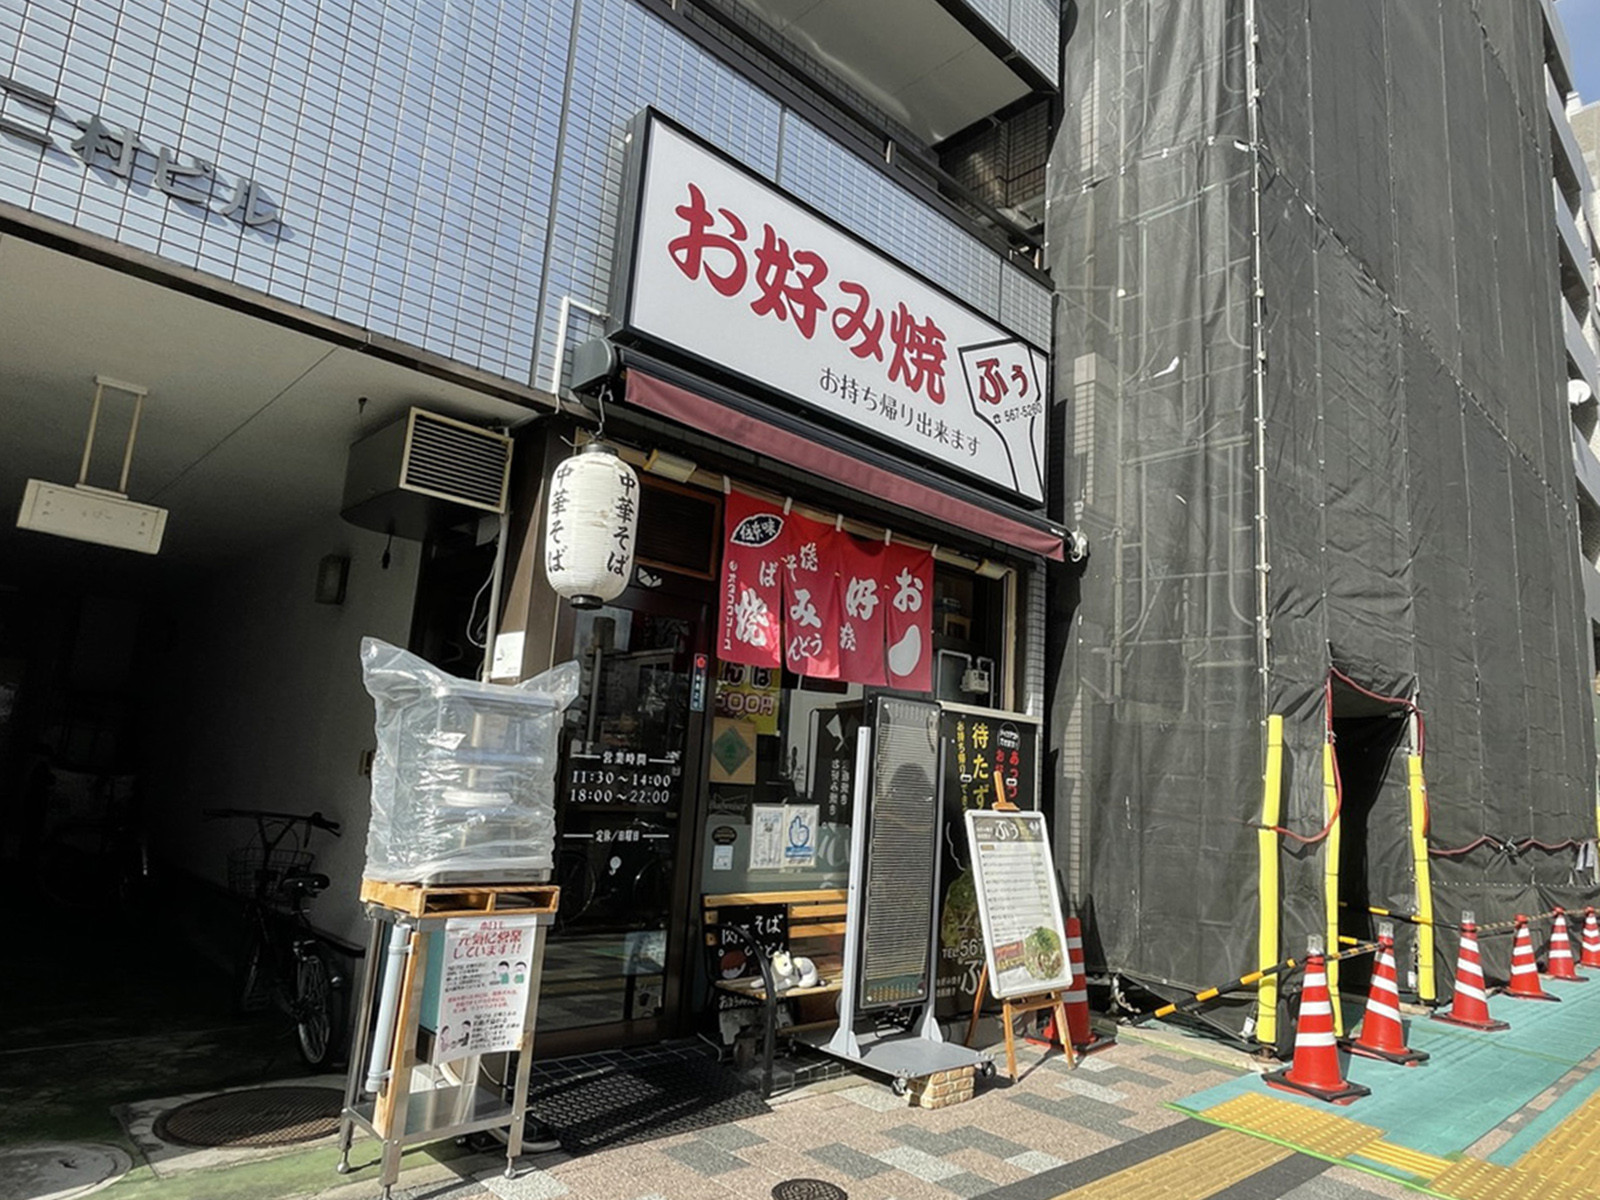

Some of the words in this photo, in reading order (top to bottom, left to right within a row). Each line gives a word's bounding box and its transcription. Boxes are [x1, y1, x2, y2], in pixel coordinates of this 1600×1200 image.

[668, 182, 947, 405] お好み焼
[819, 367, 981, 457] お持ち帰り出来ます
[549, 463, 574, 573] 中華そば
[607, 472, 636, 577] 中華そば
[603, 751, 647, 766] 営業時間
